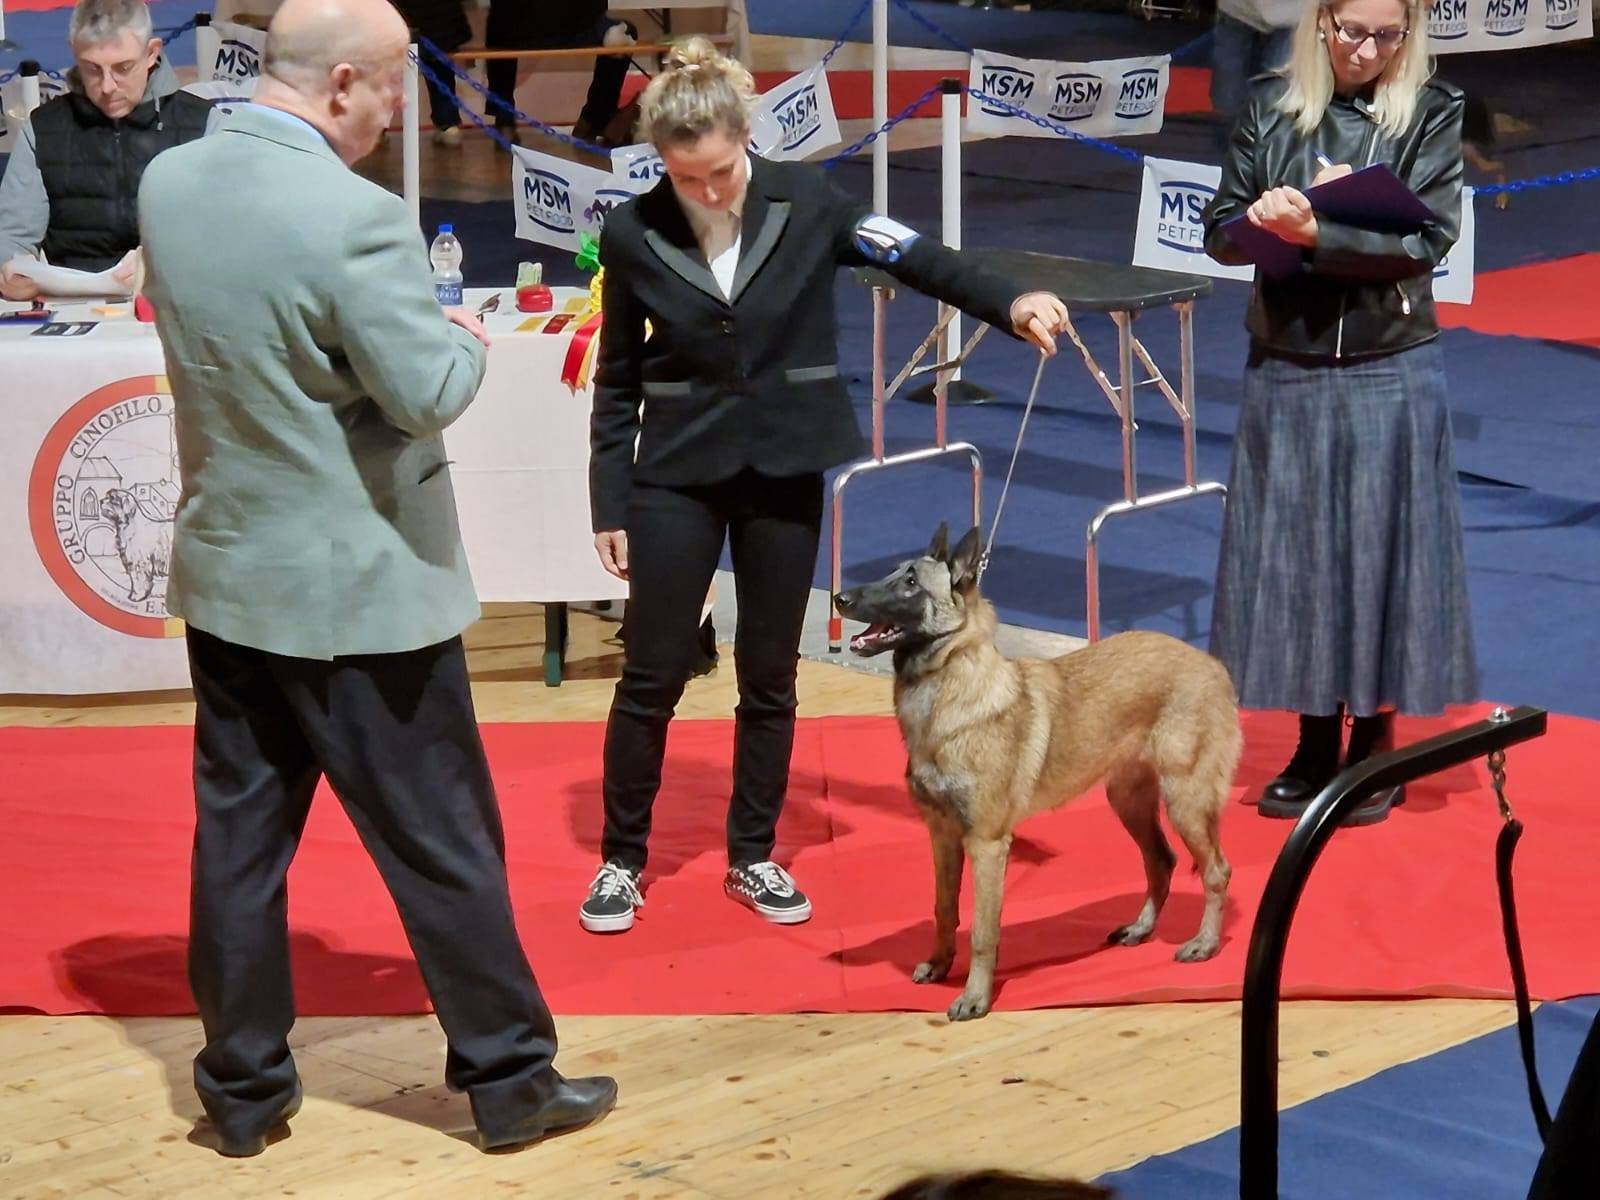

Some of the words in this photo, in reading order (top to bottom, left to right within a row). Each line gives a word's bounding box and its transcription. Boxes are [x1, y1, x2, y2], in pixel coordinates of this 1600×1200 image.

[1428, 0, 1467, 21] MSM
[1486, 0, 1529, 18] MSM
[215, 48, 260, 77] MSM
[982, 72, 1034, 98] MSM
[1055, 81, 1102, 104] MSM
[1119, 77, 1158, 100] MSM
[777, 90, 817, 133] MSM
[524, 176, 572, 213] MSM
[1160, 192, 1212, 225] MS
[69, 396, 163, 460] CINOFILO
[56, 474, 86, 566] GRUPPO
